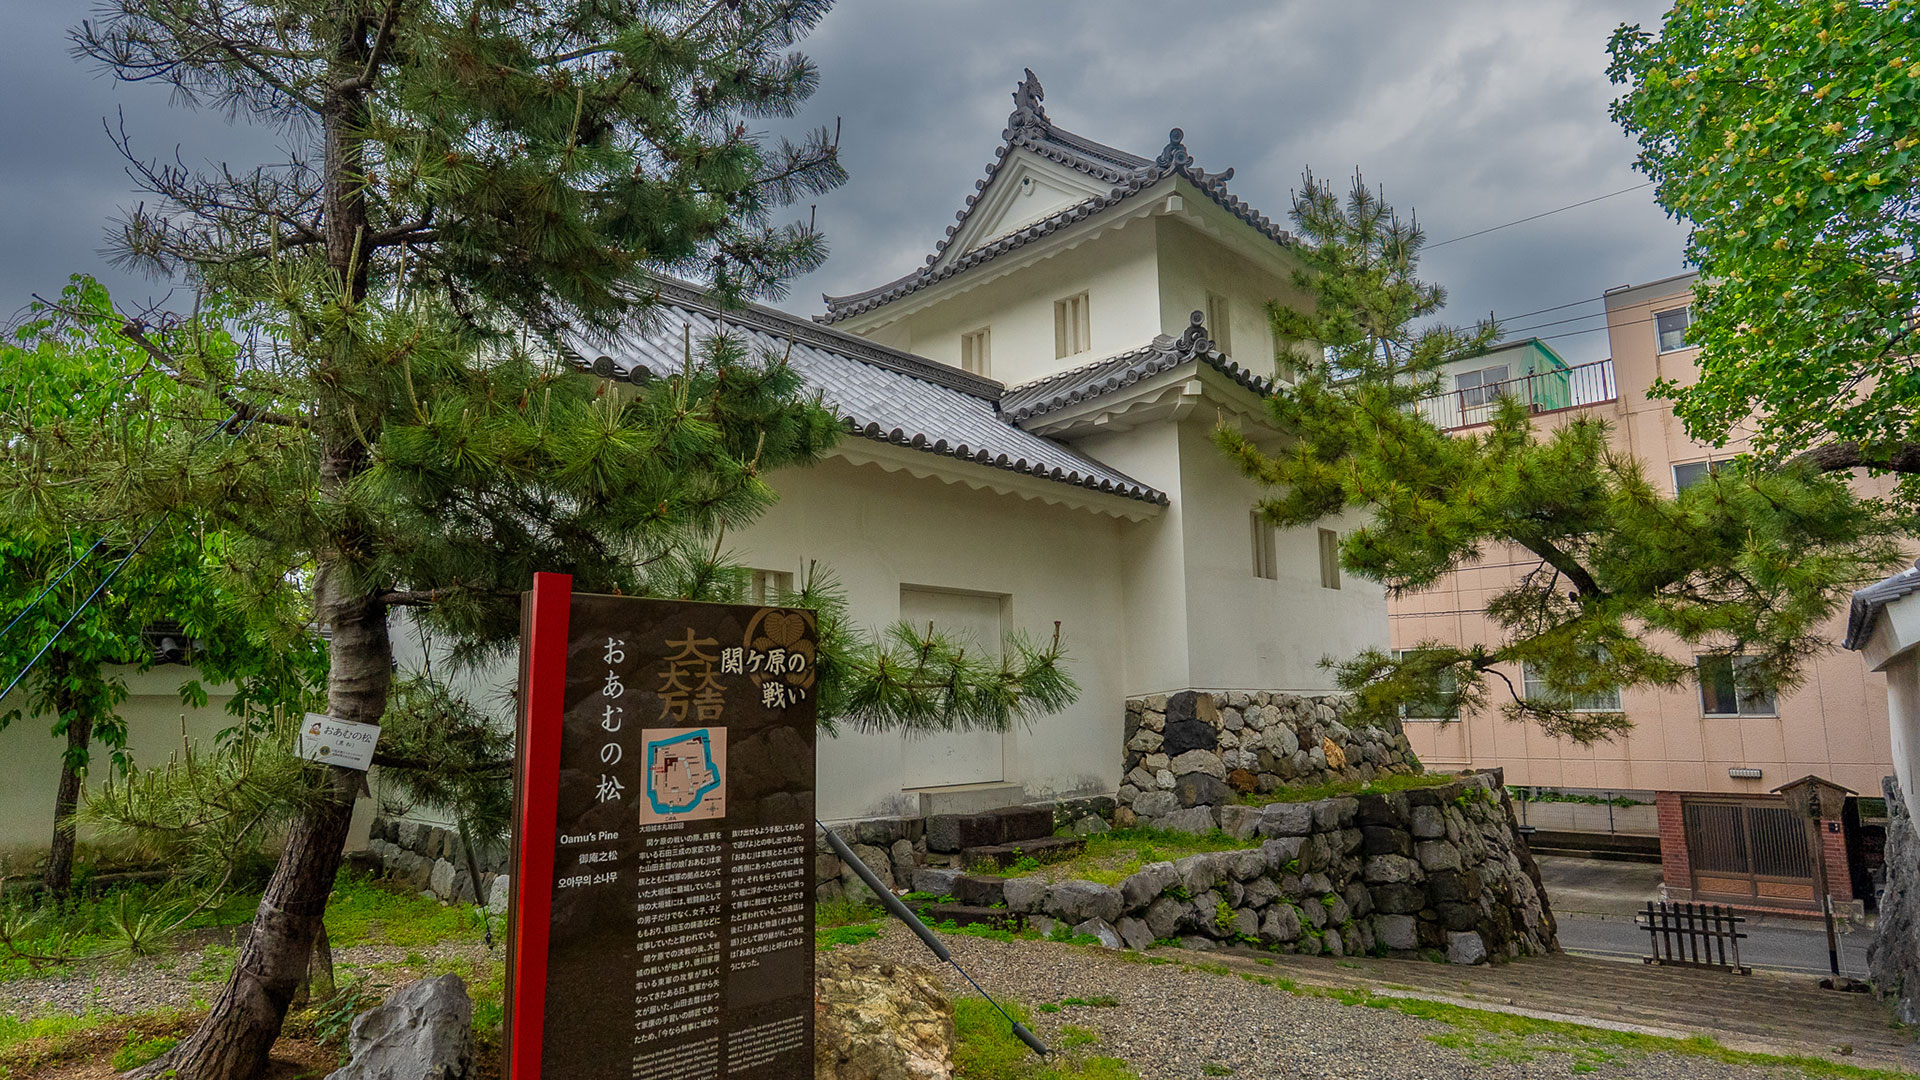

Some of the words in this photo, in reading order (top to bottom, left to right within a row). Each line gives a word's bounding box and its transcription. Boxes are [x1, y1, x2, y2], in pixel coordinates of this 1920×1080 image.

[761, 681, 806, 709] 戦い
[595, 637, 625, 803] おあむの松
[324, 726, 372, 743] おあむの松
[560, 832, 596, 844] Oamu's
[598, 830, 619, 840] Pine
[558, 874, 592, 888] 오아무의
[593, 871, 618, 884] 소나무
